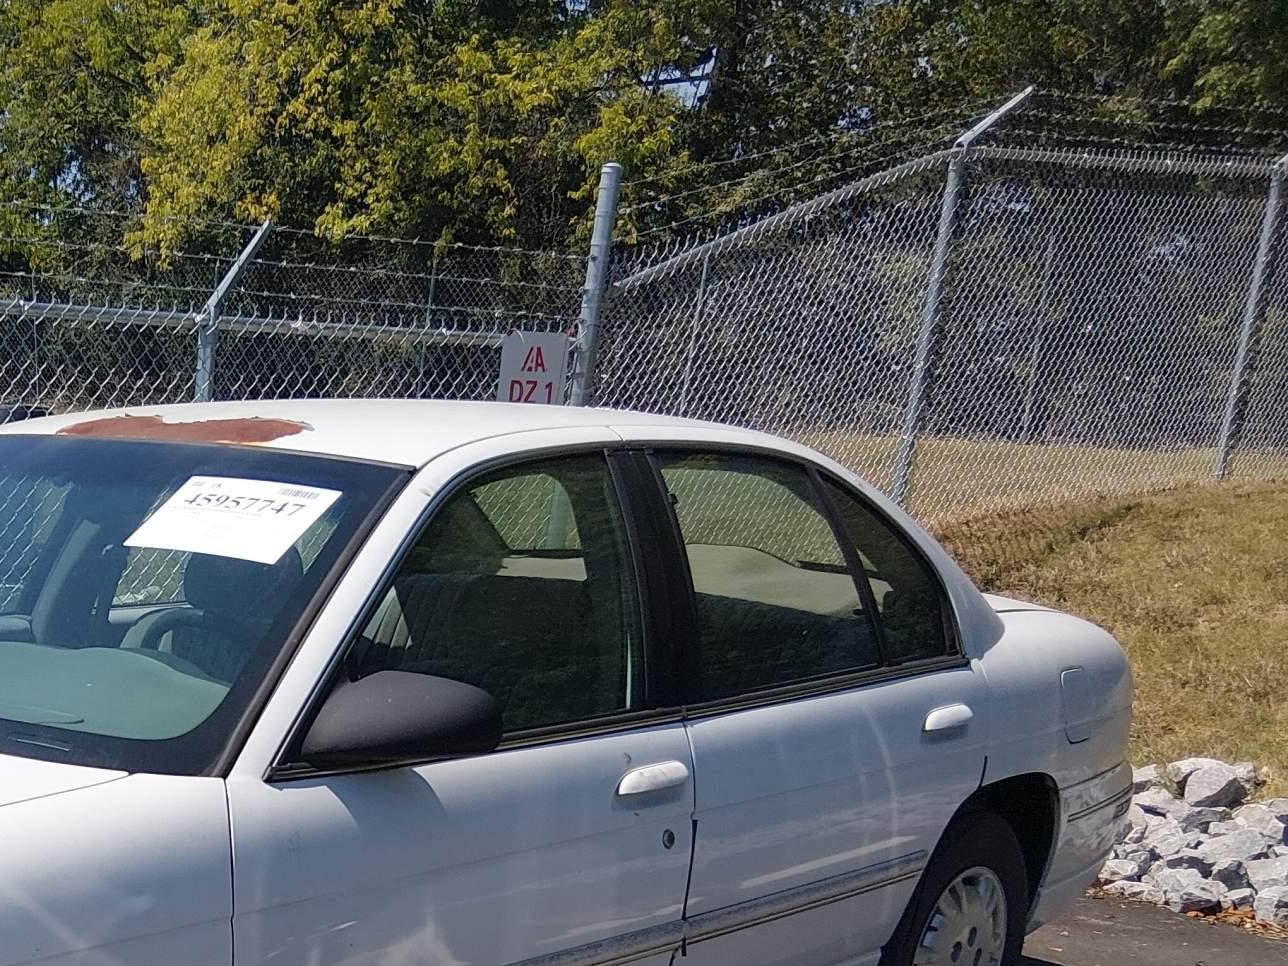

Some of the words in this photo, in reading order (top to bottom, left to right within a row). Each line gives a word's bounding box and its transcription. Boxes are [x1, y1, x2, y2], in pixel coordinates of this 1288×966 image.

[508, 380, 538, 404] DZ
[544, 381, 553, 405] 1
[184, 492, 307, 517] 45957747
